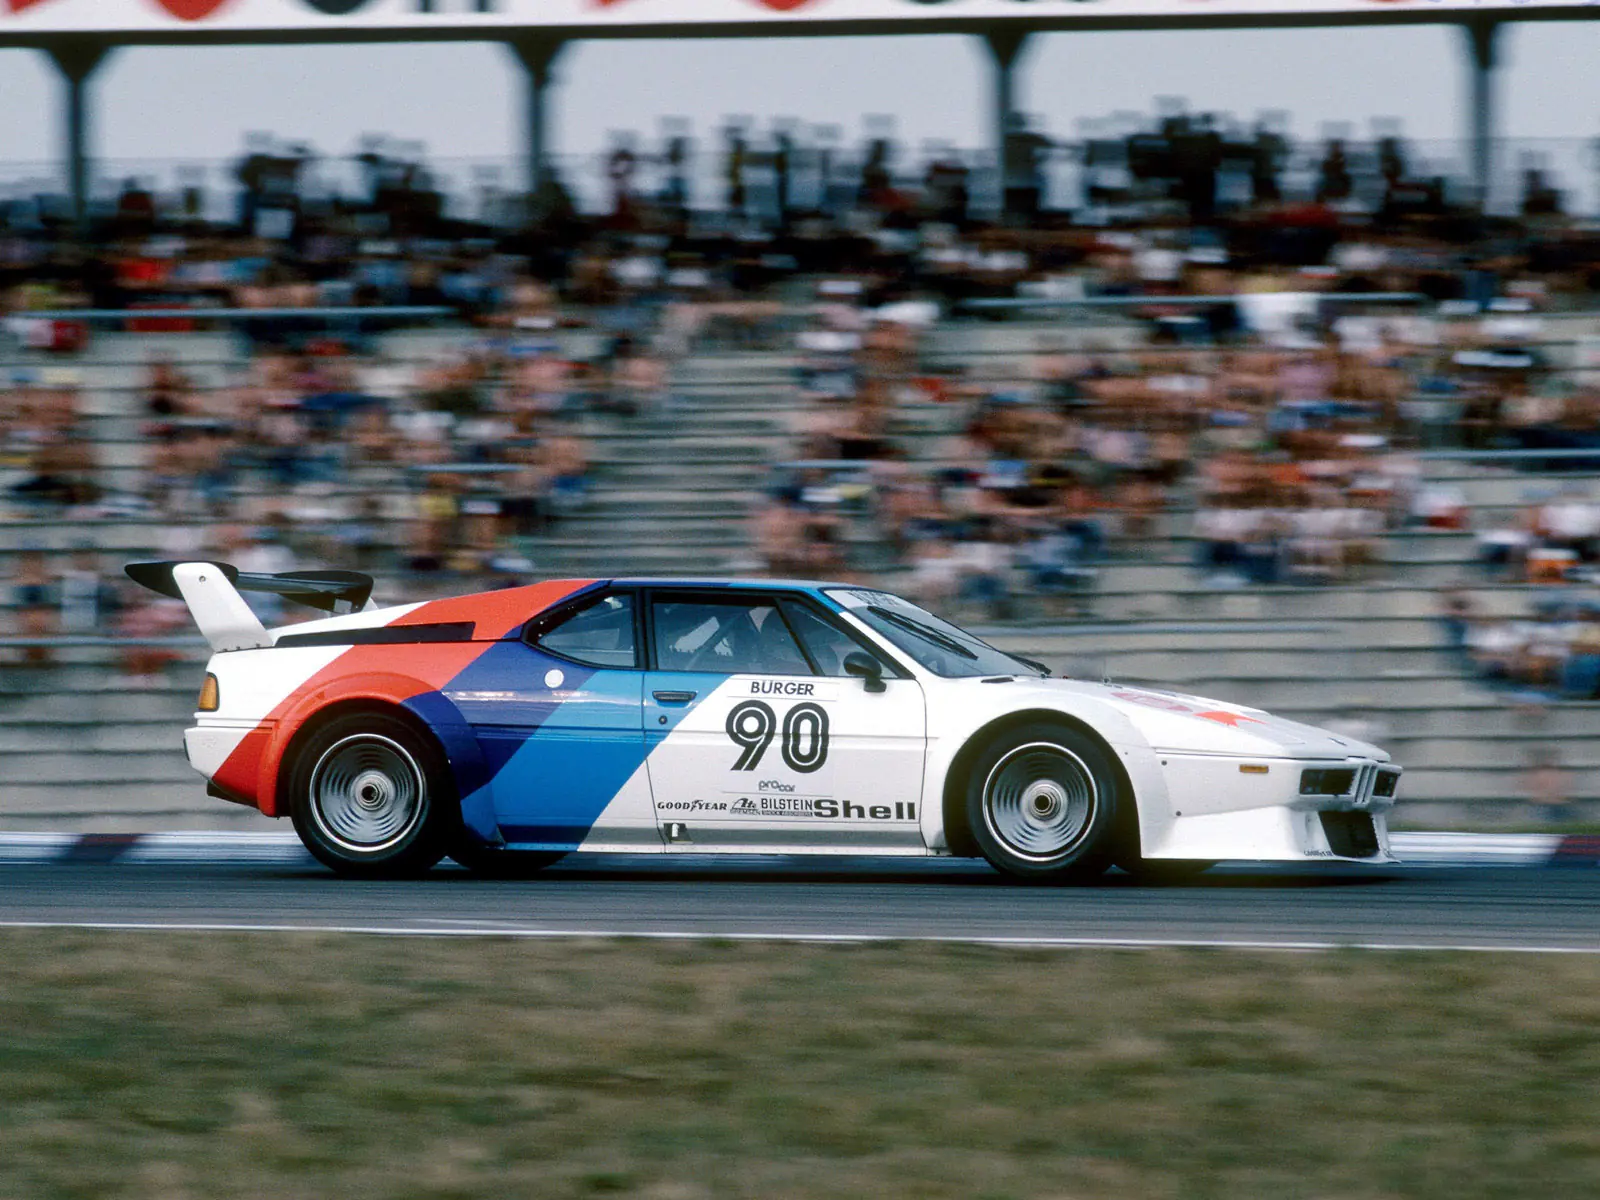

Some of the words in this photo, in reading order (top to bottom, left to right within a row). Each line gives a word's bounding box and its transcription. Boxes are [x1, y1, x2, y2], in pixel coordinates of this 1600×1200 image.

[725, 699, 829, 774] 90
[657, 799, 728, 812] GOODYEAR
[761, 798, 813, 811] BILSTEIN
[814, 798, 915, 820] Shell
